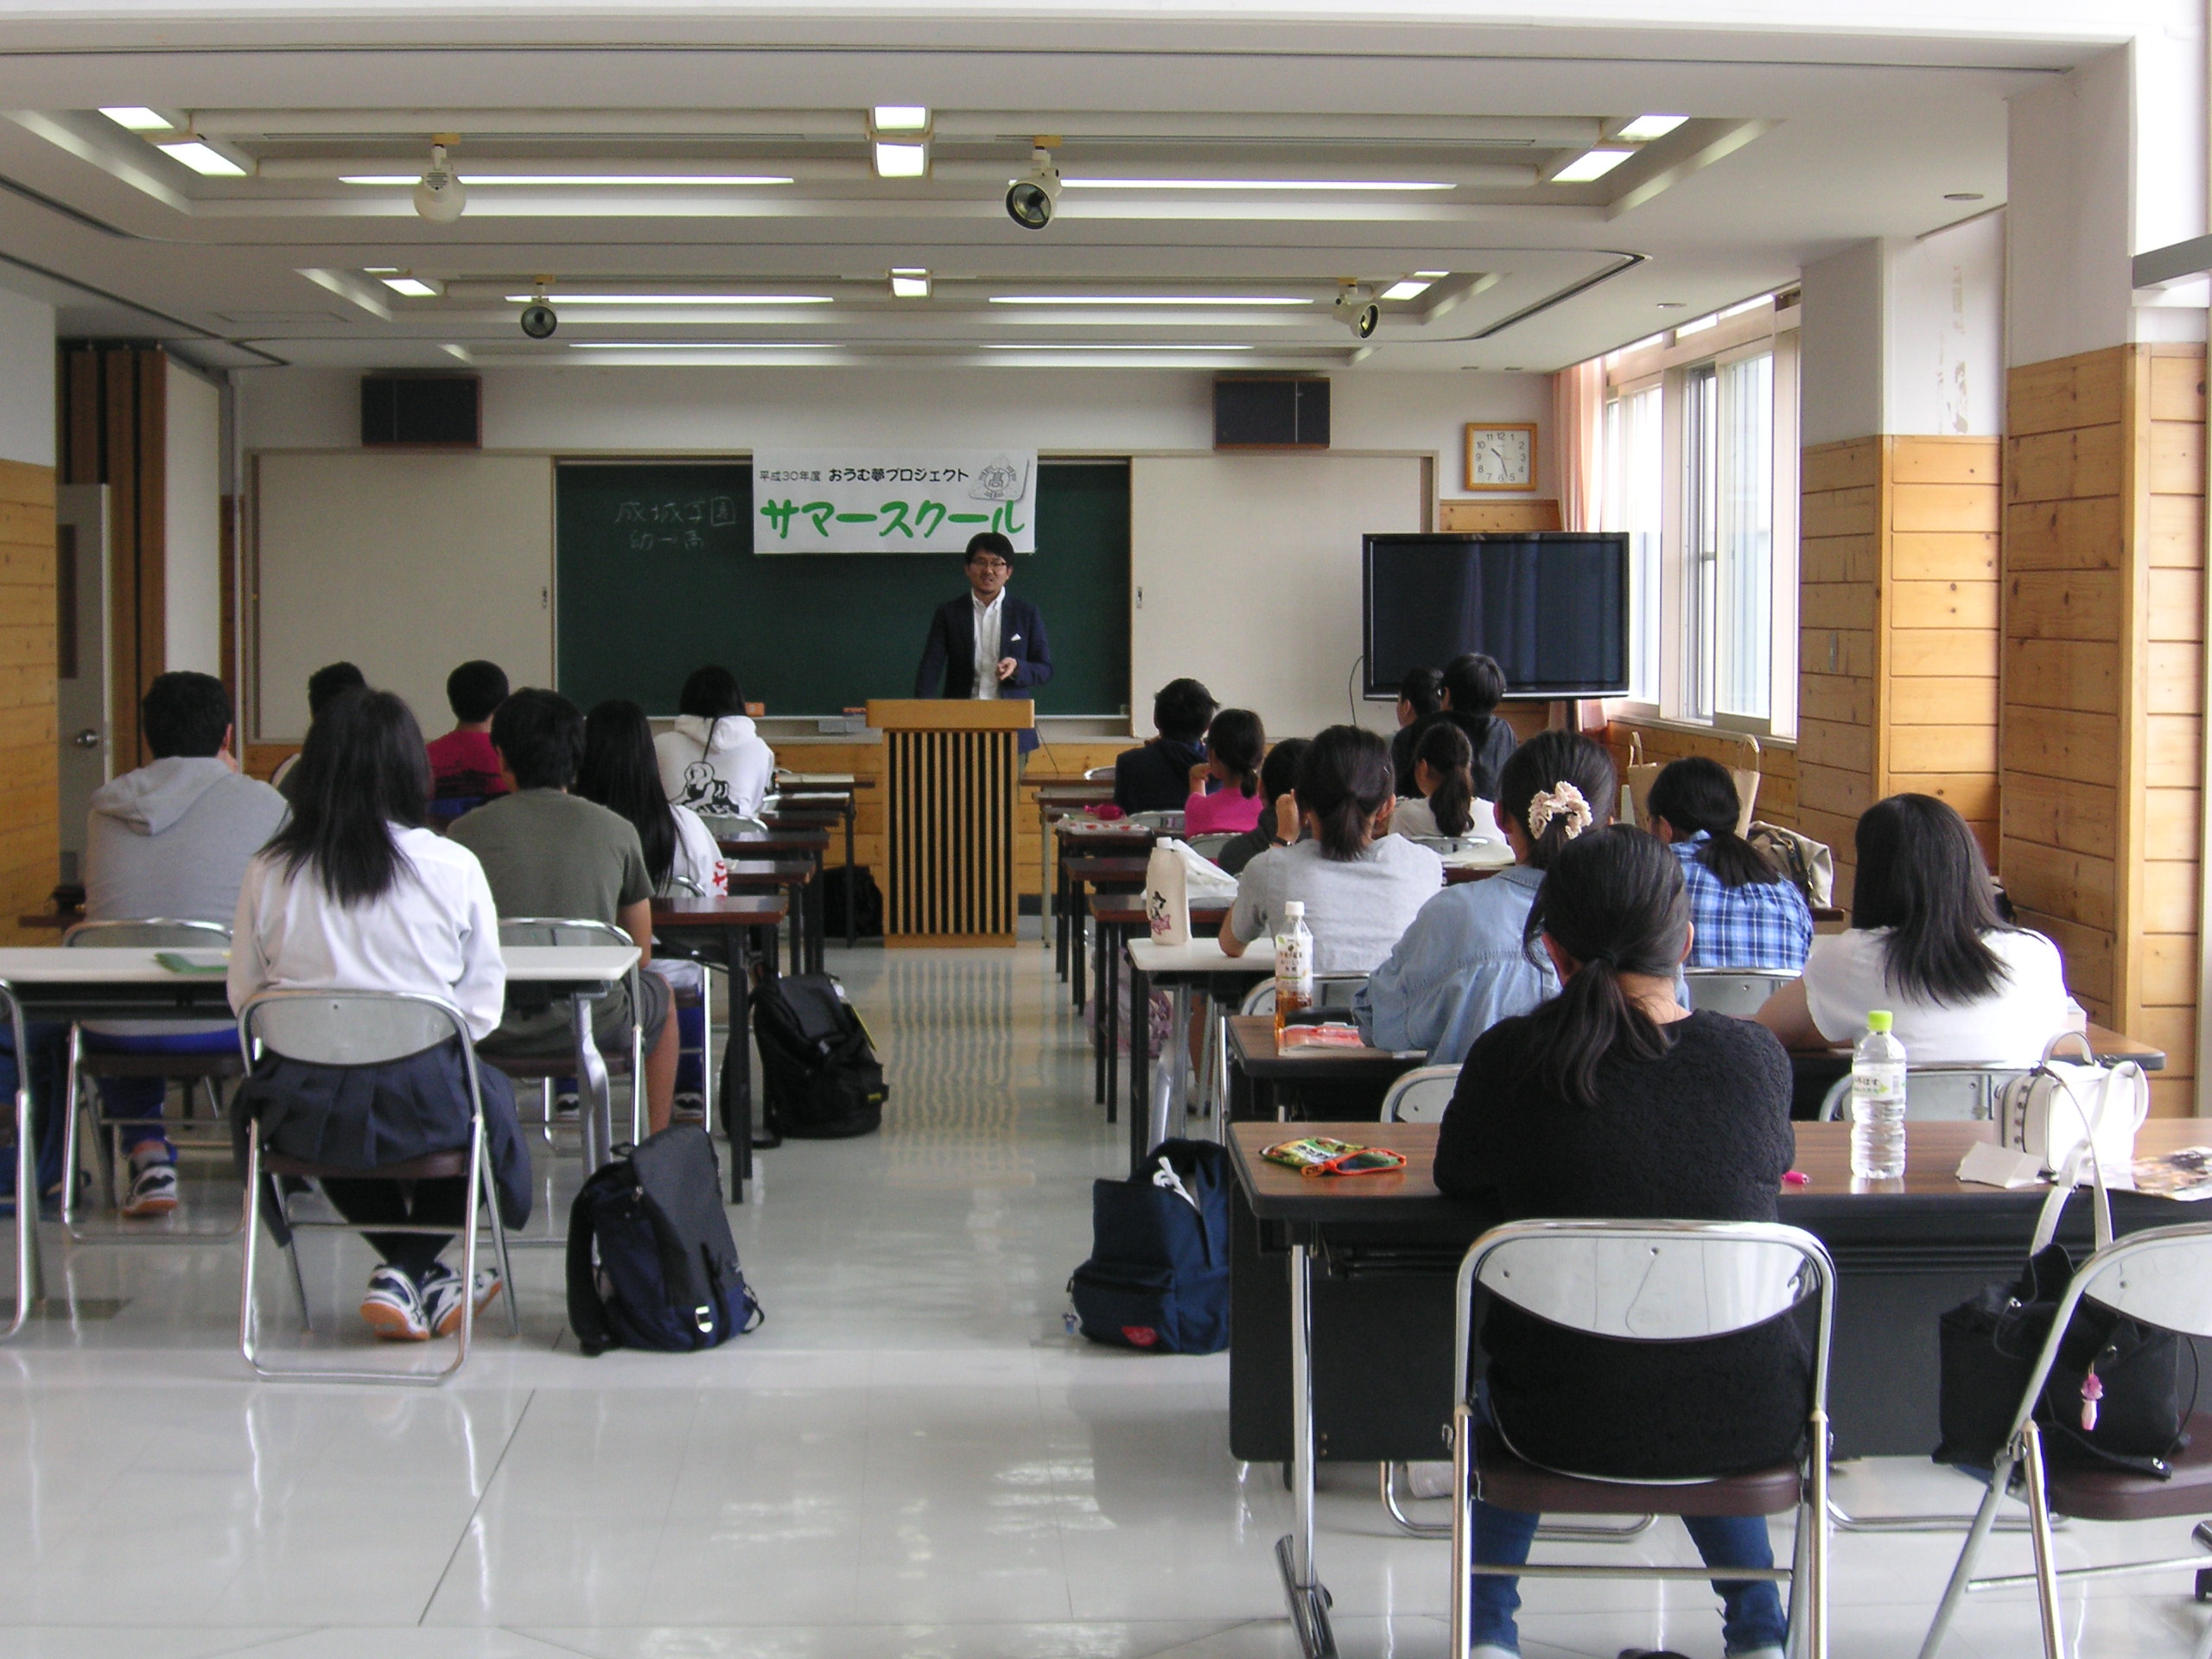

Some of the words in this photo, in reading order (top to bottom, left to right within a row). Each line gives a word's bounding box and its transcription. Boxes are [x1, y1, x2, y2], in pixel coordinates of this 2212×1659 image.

[760, 470, 821, 482] 平成30年度
[829, 467, 969, 482] おうむ夢プロジェクト
[760, 499, 1026, 539] サマースクール
